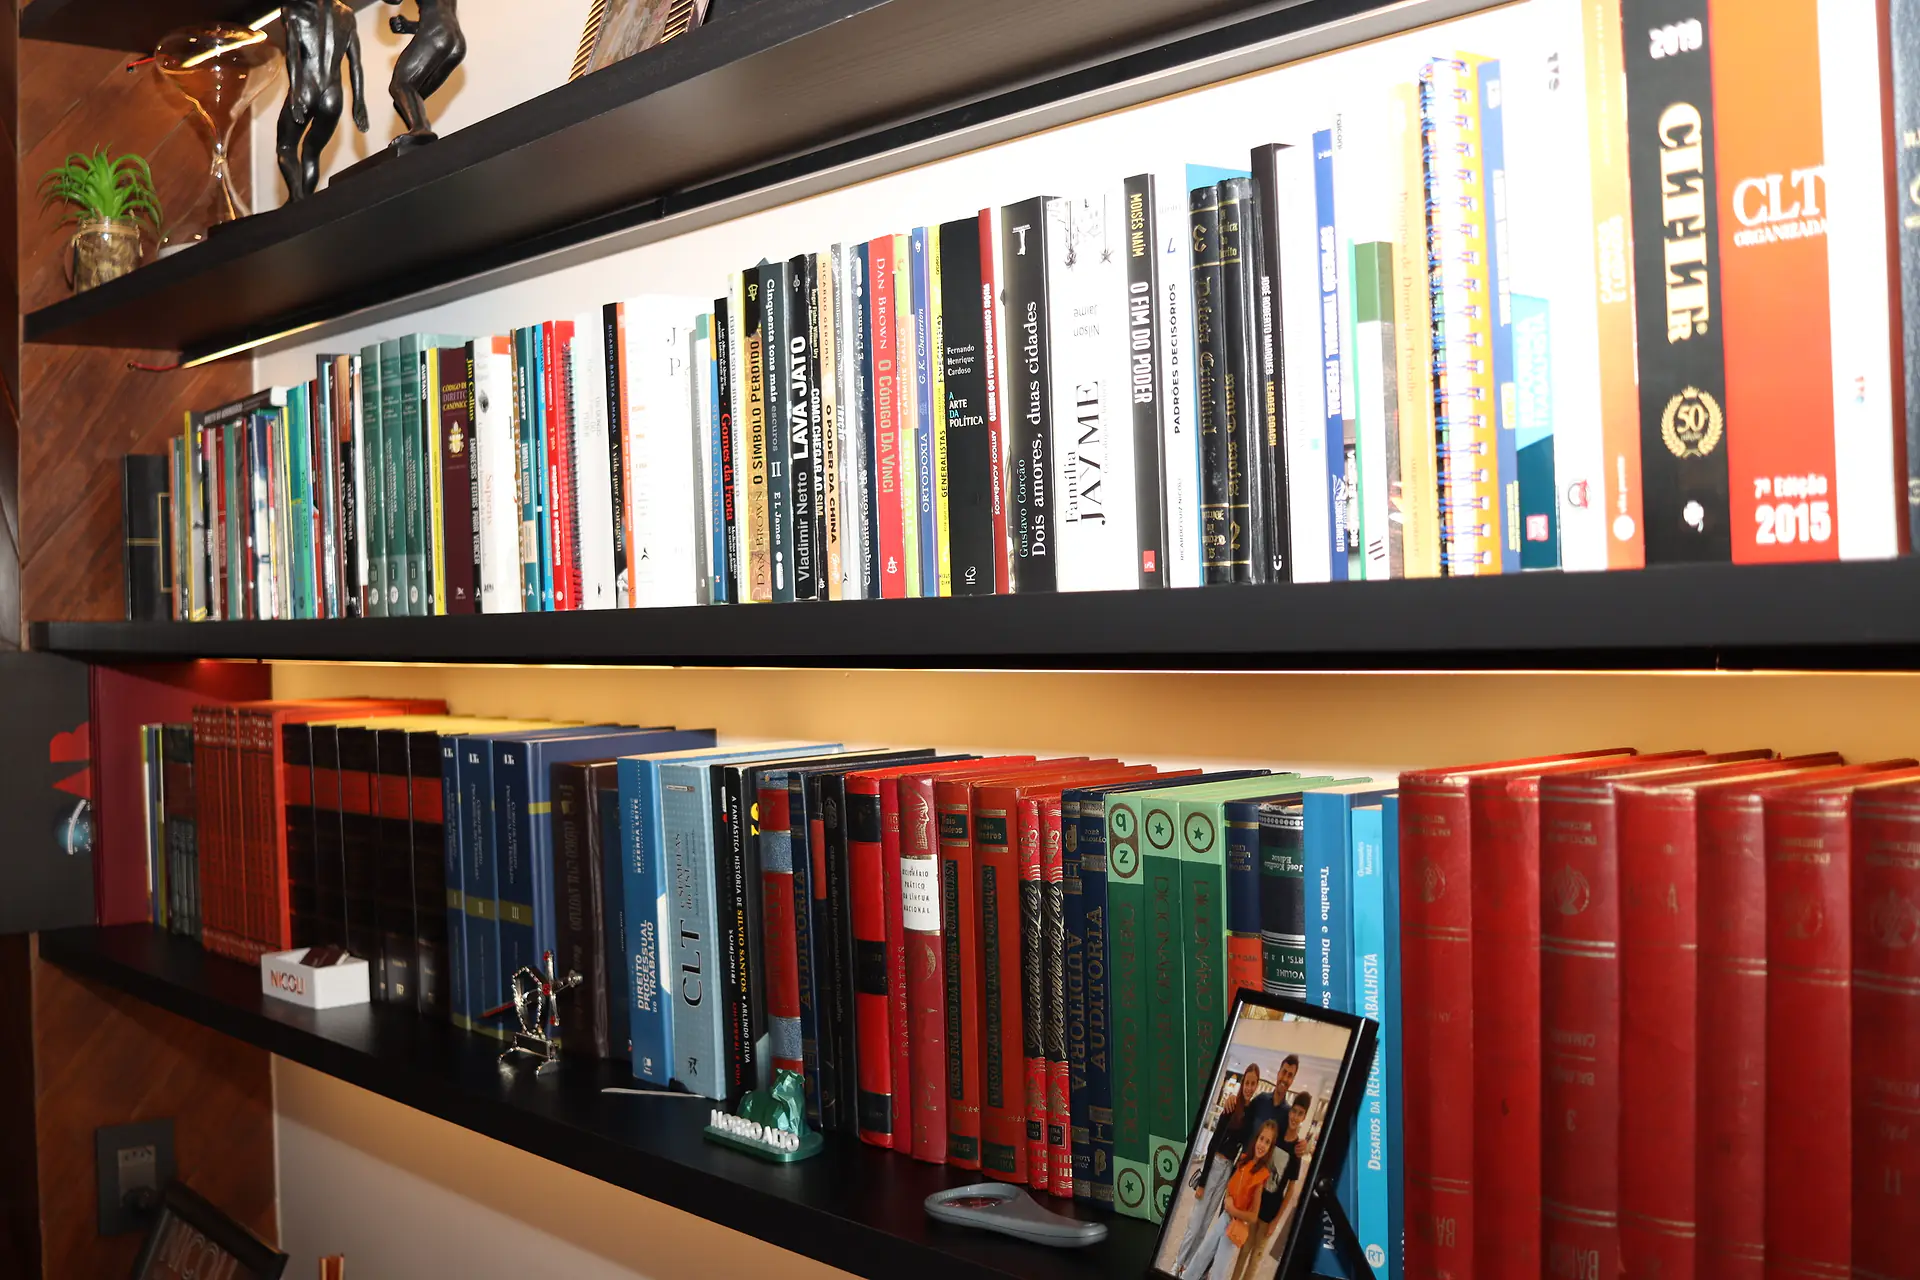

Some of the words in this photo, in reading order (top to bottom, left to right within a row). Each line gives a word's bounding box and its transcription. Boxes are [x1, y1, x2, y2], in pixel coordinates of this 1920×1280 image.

[1649, 17, 1702, 60] 2019
[1130, 193, 1145, 229] MOISÉS
[1732, 165, 1828, 228] CLT
[1131, 231, 1147, 257] NAÍM
[1399, 191, 1409, 254] Princípios
[876, 258, 886, 289] DAN
[1402, 257, 1411, 270] de
[983, 283, 992, 308] VISÕES
[1130, 281, 1149, 293] O
[1261, 276, 1271, 296] JOSÉ
[1402, 276, 1413, 320] Direito
[766, 279, 775, 342] Cinquenta
[878, 297, 887, 349] BROWN
[1132, 296, 1150, 326] FIM
[1168, 283, 1179, 366] DECISÓRIOS
[1262, 297, 1272, 334] ROBERTO
[1404, 324, 1413, 340] do
[917, 308, 925, 357] Chesterton
[947, 344, 975, 355] Fernando
[984, 309, 995, 379] CONTEMPORÂNEAS
[1024, 302, 1039, 373] cidades
[1132, 327, 1151, 350] DO
[751, 341, 761, 403] PERDIDO
[791, 336, 806, 396] JATO
[878, 359, 891, 371] O
[947, 356, 975, 365] Henrique
[947, 368, 971, 376] Cardoso
[1264, 335, 1273, 375] MARQUES
[1405, 347, 1416, 402] Trabalho
[770, 374, 778, 403] mais
[901, 368, 909, 416] CARMINE
[919, 373, 926, 384] G.
[949, 392, 959, 400] A
[988, 380, 995, 391] DO
[1133, 354, 1153, 404] PODER
[1199, 352, 1217, 436] Criminal
[1266, 381, 1275, 414] LEADER
[811, 388, 820, 422] COMO
[826, 405, 832, 415] O
[879, 376, 893, 429] CÓDIGO
[949, 399, 968, 410] ARTE
[949, 410, 959, 418] DA
[949, 416, 984, 428] POLÍTICA
[988, 392, 997, 422] DIREITO
[1027, 381, 1041, 425] duas
[1171, 369, 1181, 434] PADRÕES
[1677, 405, 1706, 433] 50
[722, 414, 731, 461] Gomes
[752, 408, 763, 469] SÍMBOLO
[771, 405, 779, 451] escuros
[791, 401, 808, 460] LAVA
[813, 426, 822, 472] CHEGAR
[826, 419, 835, 469] PODER
[881, 432, 894, 452] DA
[1268, 415, 1276, 446] COACH
[469, 438, 478, 479] EMPRESAS
[724, 465, 733, 482] da
[882, 454, 895, 493] VINCI
[921, 433, 929, 513] ORTODOXIA
[939, 430, 947, 498] GENERALISTAS
[1031, 434, 1044, 507] amores,
[1077, 381, 1106, 526] JAYME
[471, 482, 479, 508] FEITAS
[484, 474, 493, 525] Sapiens
[612, 475, 620, 496] quer
[753, 476, 763, 485] O
[797, 472, 808, 514] Netto
[815, 477, 822, 492] AO
[828, 473, 834, 493] DA
[992, 465, 1000, 515] ACADÊMICOS
[1016, 459, 1027, 504] Corção
[472, 511, 480, 532] PARA
[725, 485, 734, 520] Frota
[755, 491, 764, 546] BROWN
[829, 497, 837, 544] CHINA
[1755, 501, 1831, 545] 2015
[473, 535, 481, 564] VENCER
[614, 505, 622, 551] coragem
[1019, 508, 1028, 558] Gustavo
[1031, 515, 1046, 556] Dois
[757, 554, 765, 585] DAN
[798, 519, 809, 581] Vladimir
[731, 795, 738, 803] A
[732, 804, 741, 855] FANTÁSTICA
[1115, 813, 1127, 833] q
[734, 856, 742, 900] HISTÓRIA
[1118, 849, 1130, 865] z
[1023, 882, 1043, 931] Lar
[1046, 884, 1066, 931] Lar
[1320, 866, 1330, 922] Trabalho
[737, 909, 746, 944] SILVIO
[794, 868, 814, 1010] AUDITORIA
[1026, 929, 1042, 952] do
[1048, 929, 1064, 952] do
[640, 919, 651, 1011] PROCESSUAL
[646, 921, 656, 995] TRABALHO
[679, 919, 702, 1007] CLT
[728, 929, 737, 985] PRINCÍPIOS
[738, 945, 748, 994] SANTOS
[1321, 938, 1332, 987] Direitos
[271, 970, 306, 995] NICOLI
[635, 954, 645, 1009] DIREITO
[1026, 952, 1043, 1054] Dicionário
[1087, 906, 1108, 1073] AUDITORIA
[652, 1000, 658, 1013] DO
[742, 1001, 750, 1036] ARLINDO
[1048, 951, 1067, 1059] Dicionário
[1066, 929, 1086, 1094] AUDITORIA
